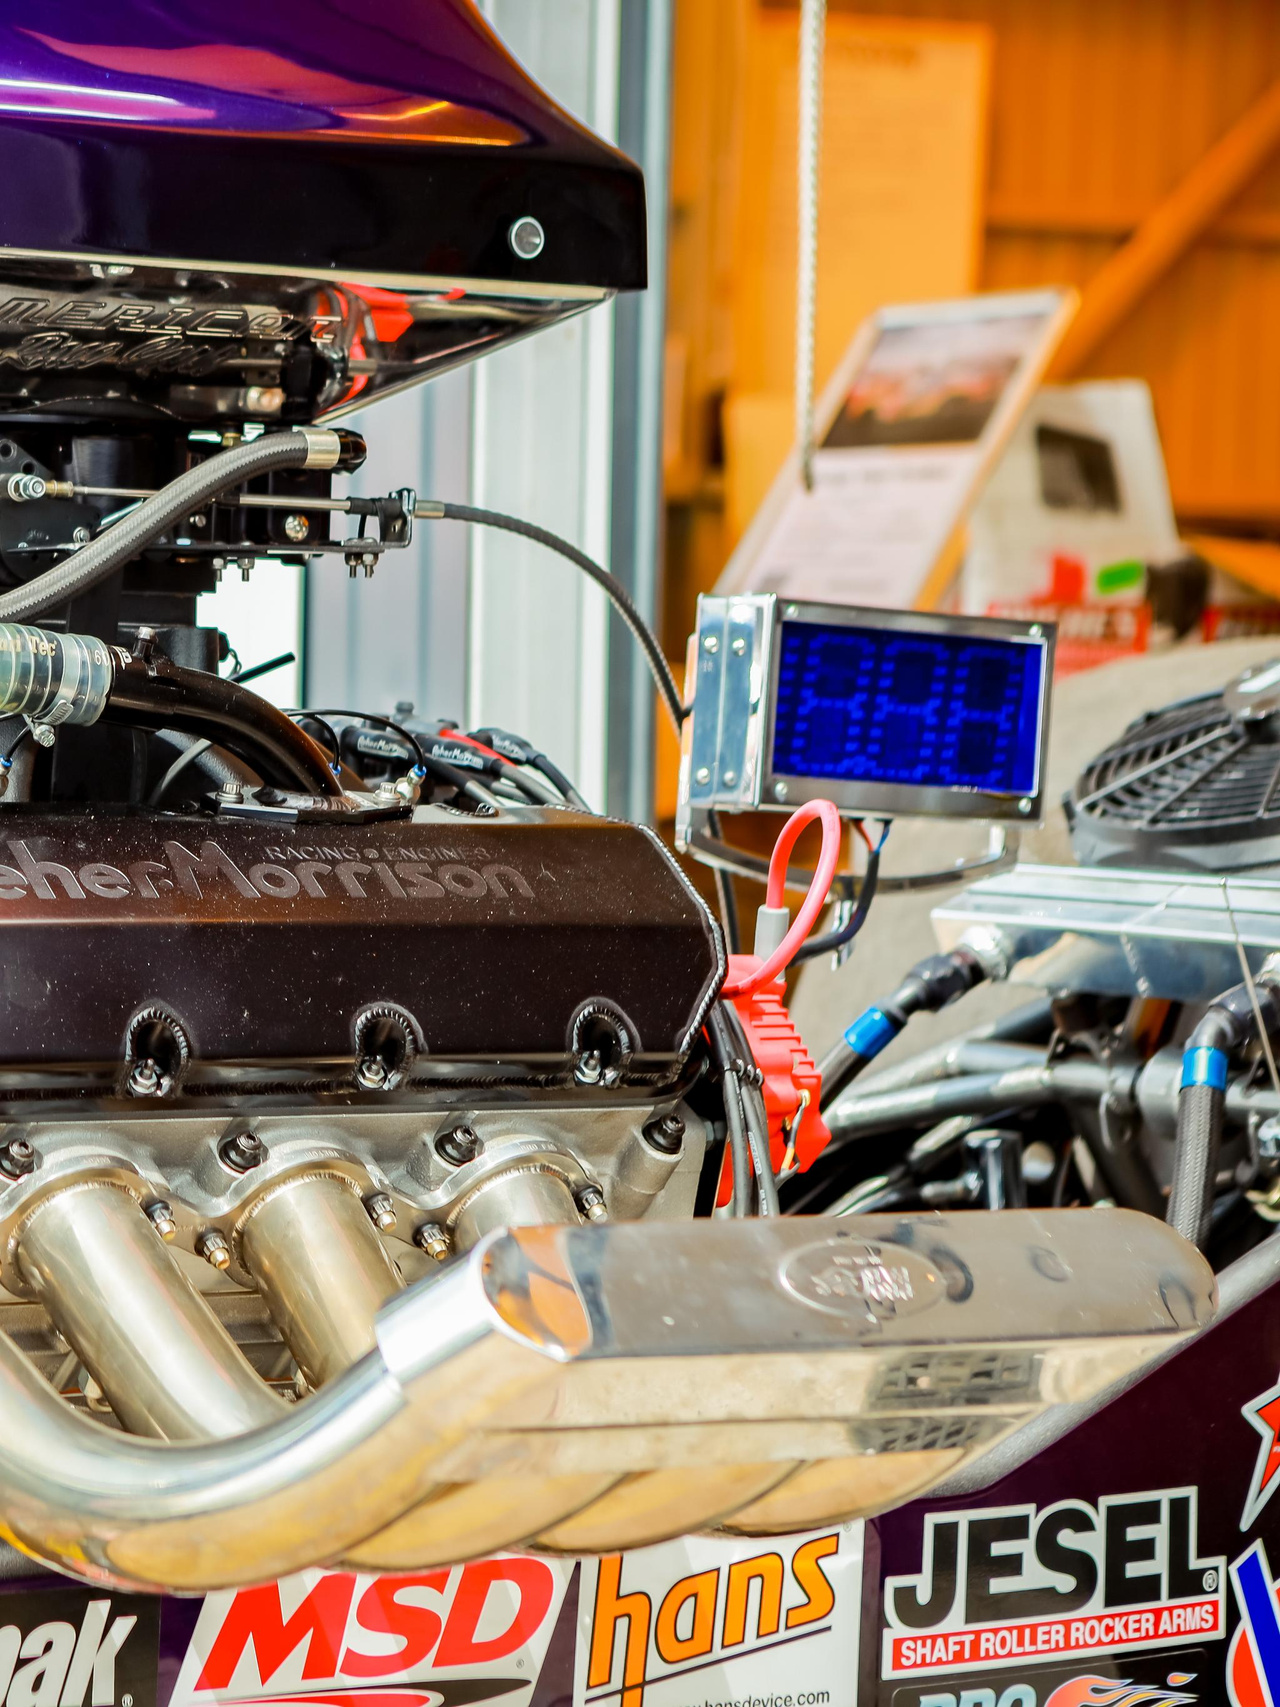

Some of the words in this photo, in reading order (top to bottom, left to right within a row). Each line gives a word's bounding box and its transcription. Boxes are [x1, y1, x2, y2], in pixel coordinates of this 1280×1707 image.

[28, 635, 57, 657] Tec
[265, 846, 362, 861] RACING
[893, 1495, 1218, 1630] JESEL
[194, 1557, 554, 1691] MSD
[586, 1532, 840, 1707] hans
[900, 1634, 975, 1666] SHAFT
[980, 1625, 1065, 1657] ROLLER
[1070, 1616, 1154, 1651] ROCKER
[1157, 1604, 1215, 1636] ARMS
